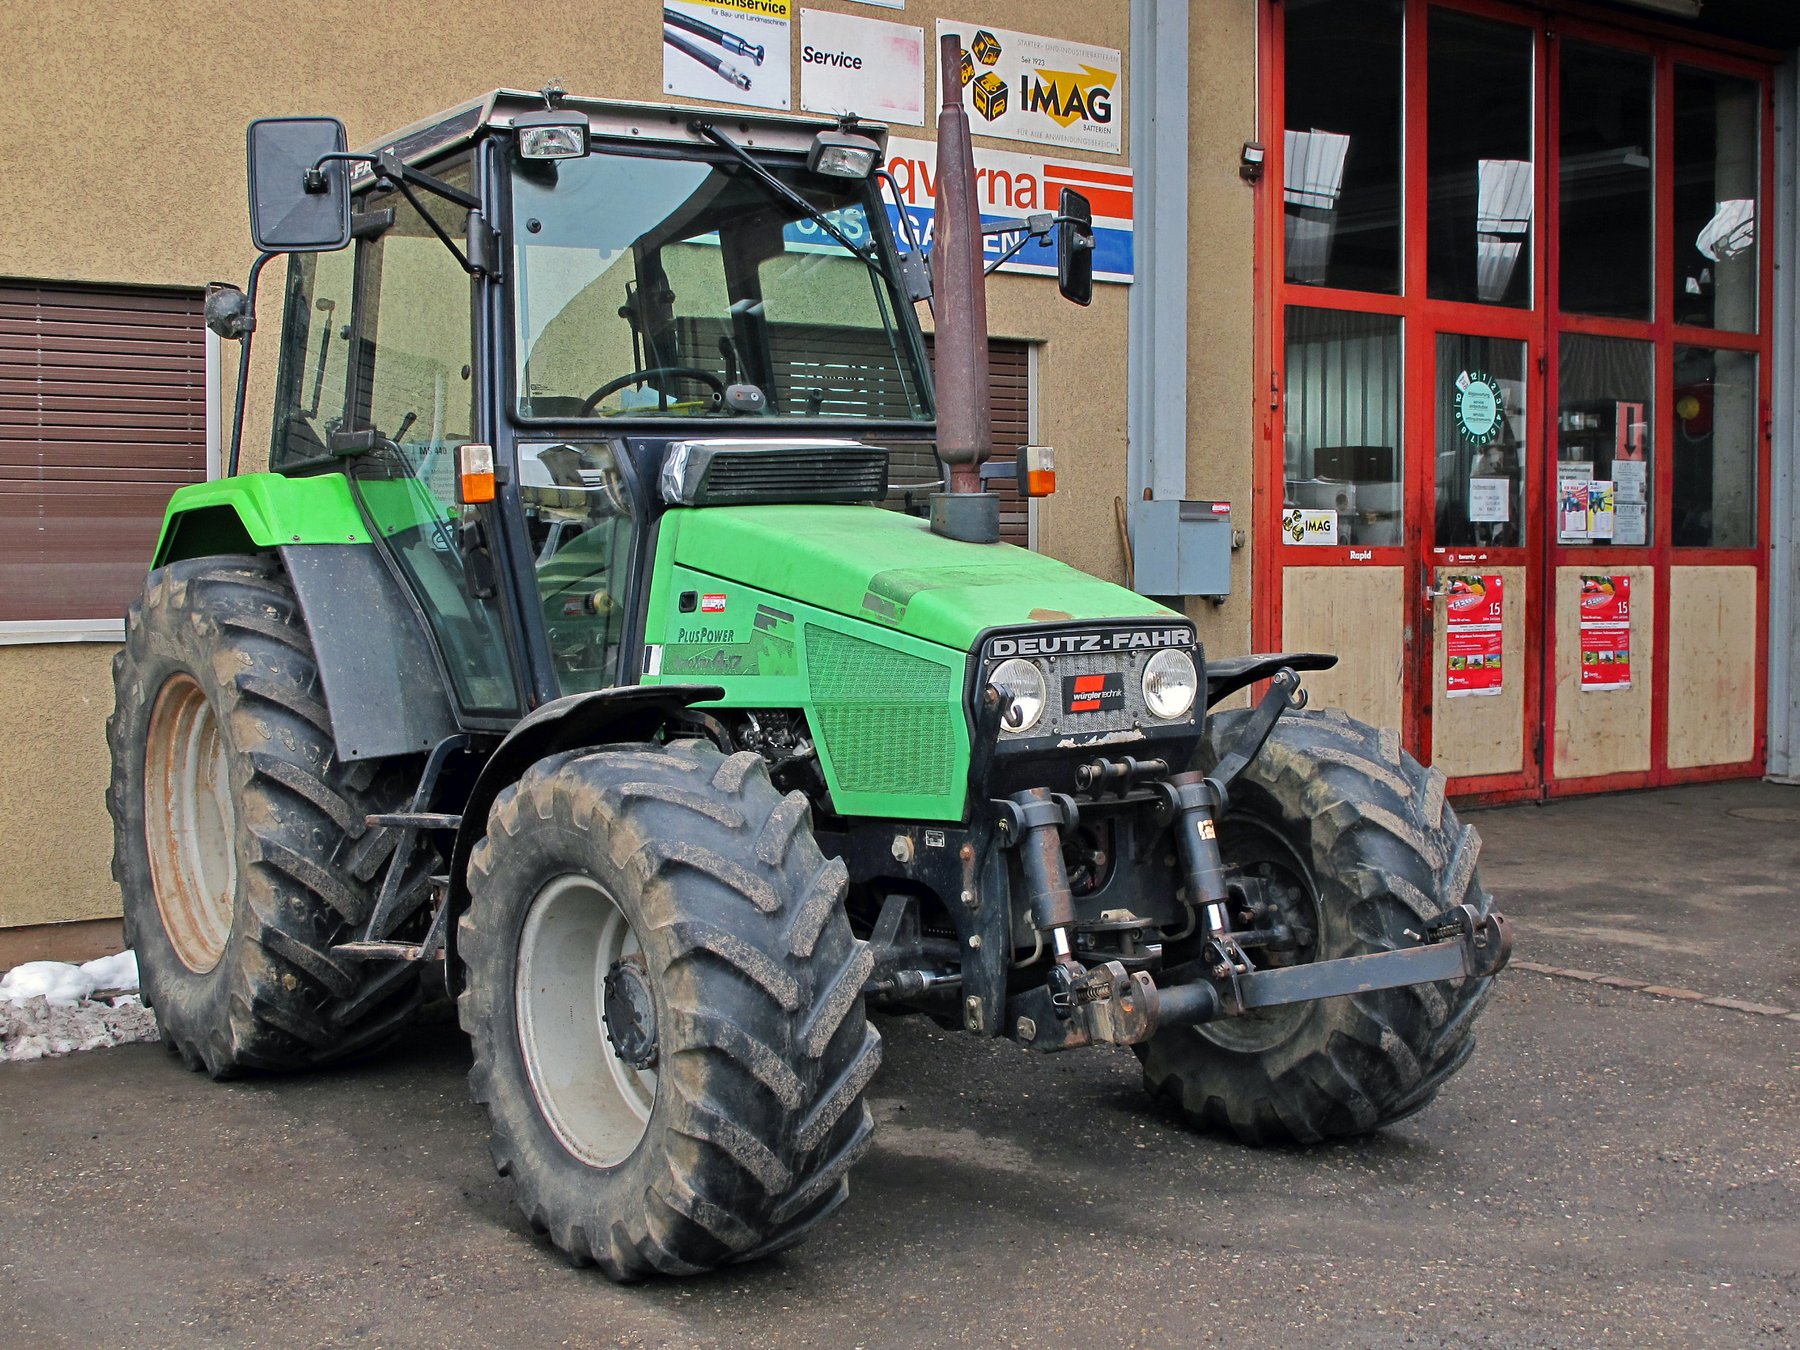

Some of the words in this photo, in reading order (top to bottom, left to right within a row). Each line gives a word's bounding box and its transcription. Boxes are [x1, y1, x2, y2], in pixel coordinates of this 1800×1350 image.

[746, 14, 788, 27] Landmaschinen
[802, 46, 862, 70] Service
[1021, 55, 1031, 64] Seit
[1032, 57, 1045, 66] 1923
[1021, 74, 1112, 124] IMAG
[1083, 124, 1112, 134] BATTERIEN
[1305, 520, 1331, 532] IMAG
[1349, 550, 1372, 561] Rapid
[1489, 602, 1501, 616] 15
[1617, 601, 1628, 614] 15
[993, 629, 1190, 657] DEUTZ-FAHR
